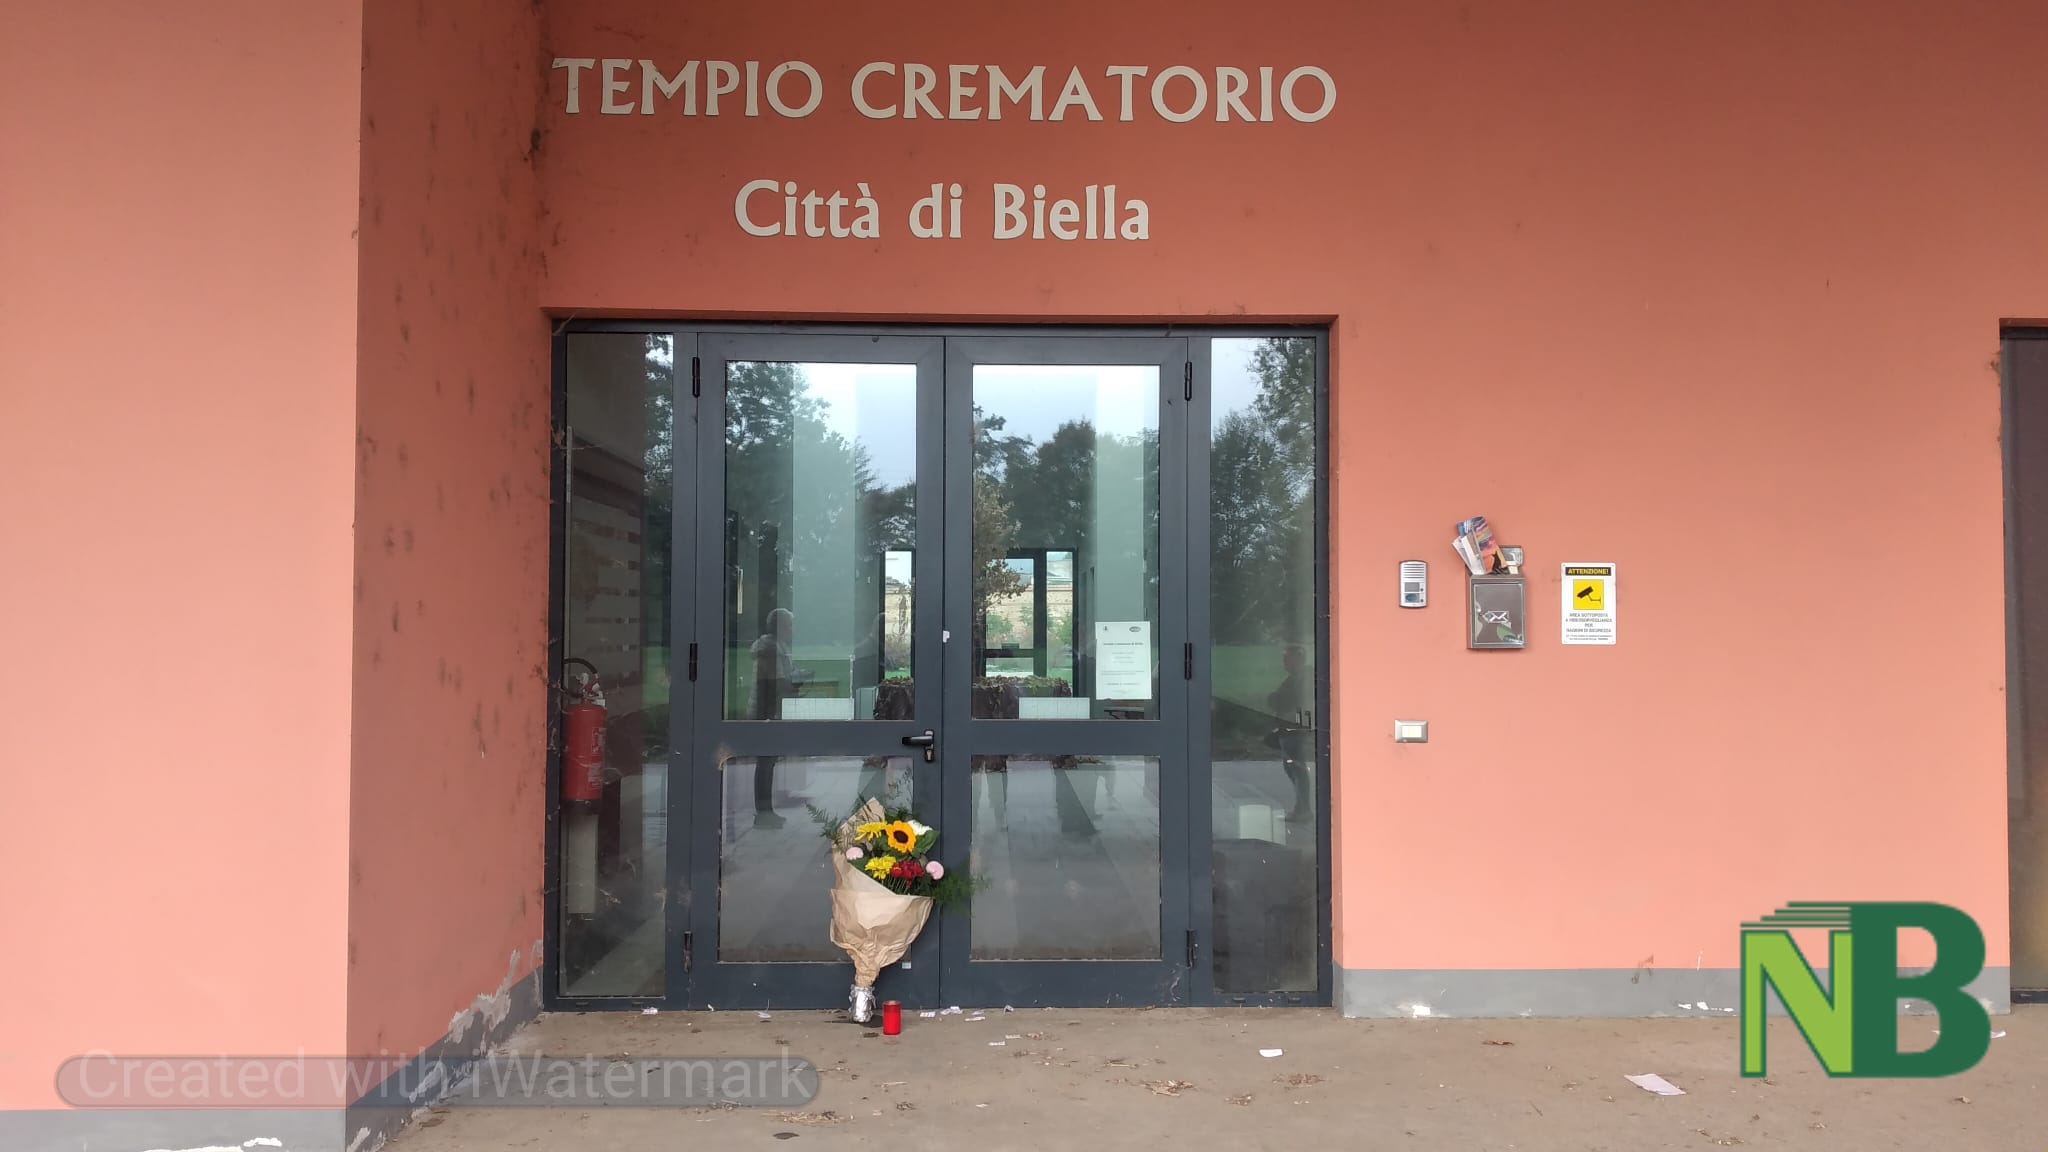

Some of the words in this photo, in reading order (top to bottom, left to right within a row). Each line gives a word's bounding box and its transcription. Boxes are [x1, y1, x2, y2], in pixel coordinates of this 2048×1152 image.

[552, 57, 824, 119] TEMPIO
[851, 61, 1338, 123] CREMATORIO
[734, 179, 881, 239] Città
[909, 182, 963, 239] di
[993, 183, 1150, 241] Biella
